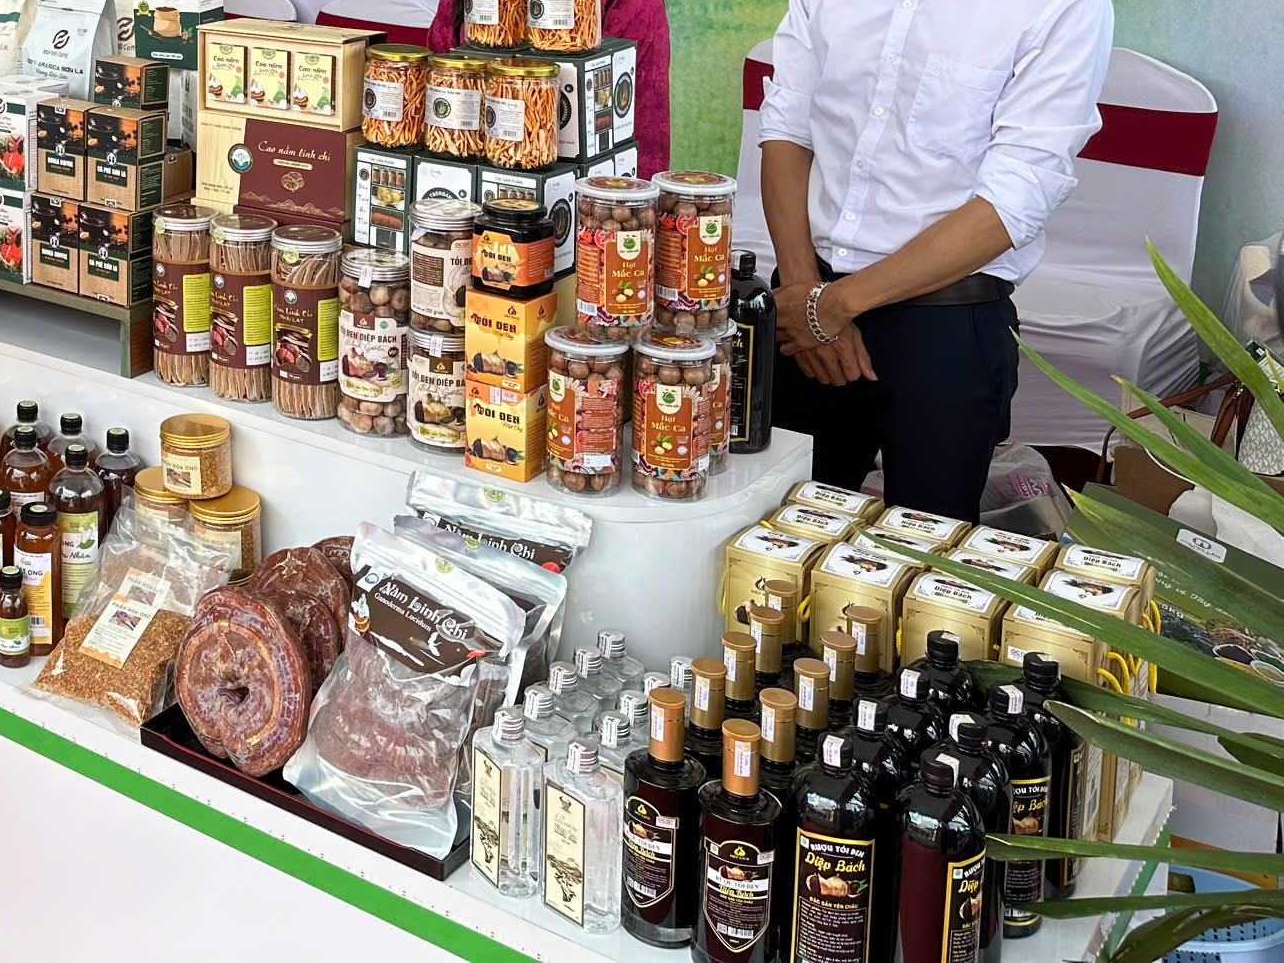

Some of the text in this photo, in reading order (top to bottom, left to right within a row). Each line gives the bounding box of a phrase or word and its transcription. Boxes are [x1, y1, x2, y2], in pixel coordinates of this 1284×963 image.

[38, 62, 60, 71] ARABICA
[258, 141, 331, 161] Cao nấm linh chi
[693, 252, 725, 262] Mắc Ca
[612, 268, 632, 278] Mắc
[378, 333, 397, 344] BÁCH
[558, 414, 569, 422] Ca
[651, 421, 686, 432] Mắc Ca
[26, 569, 43, 577] ONG
[374, 592, 432, 632] Ganoderma Lucidum
[408, 597, 441, 624] Linh
[810, 843, 865, 858] RƯỢU TỎI ĐEN
[805, 852, 866, 873] Diệp Bách
[958, 879, 979, 893] Diệp
